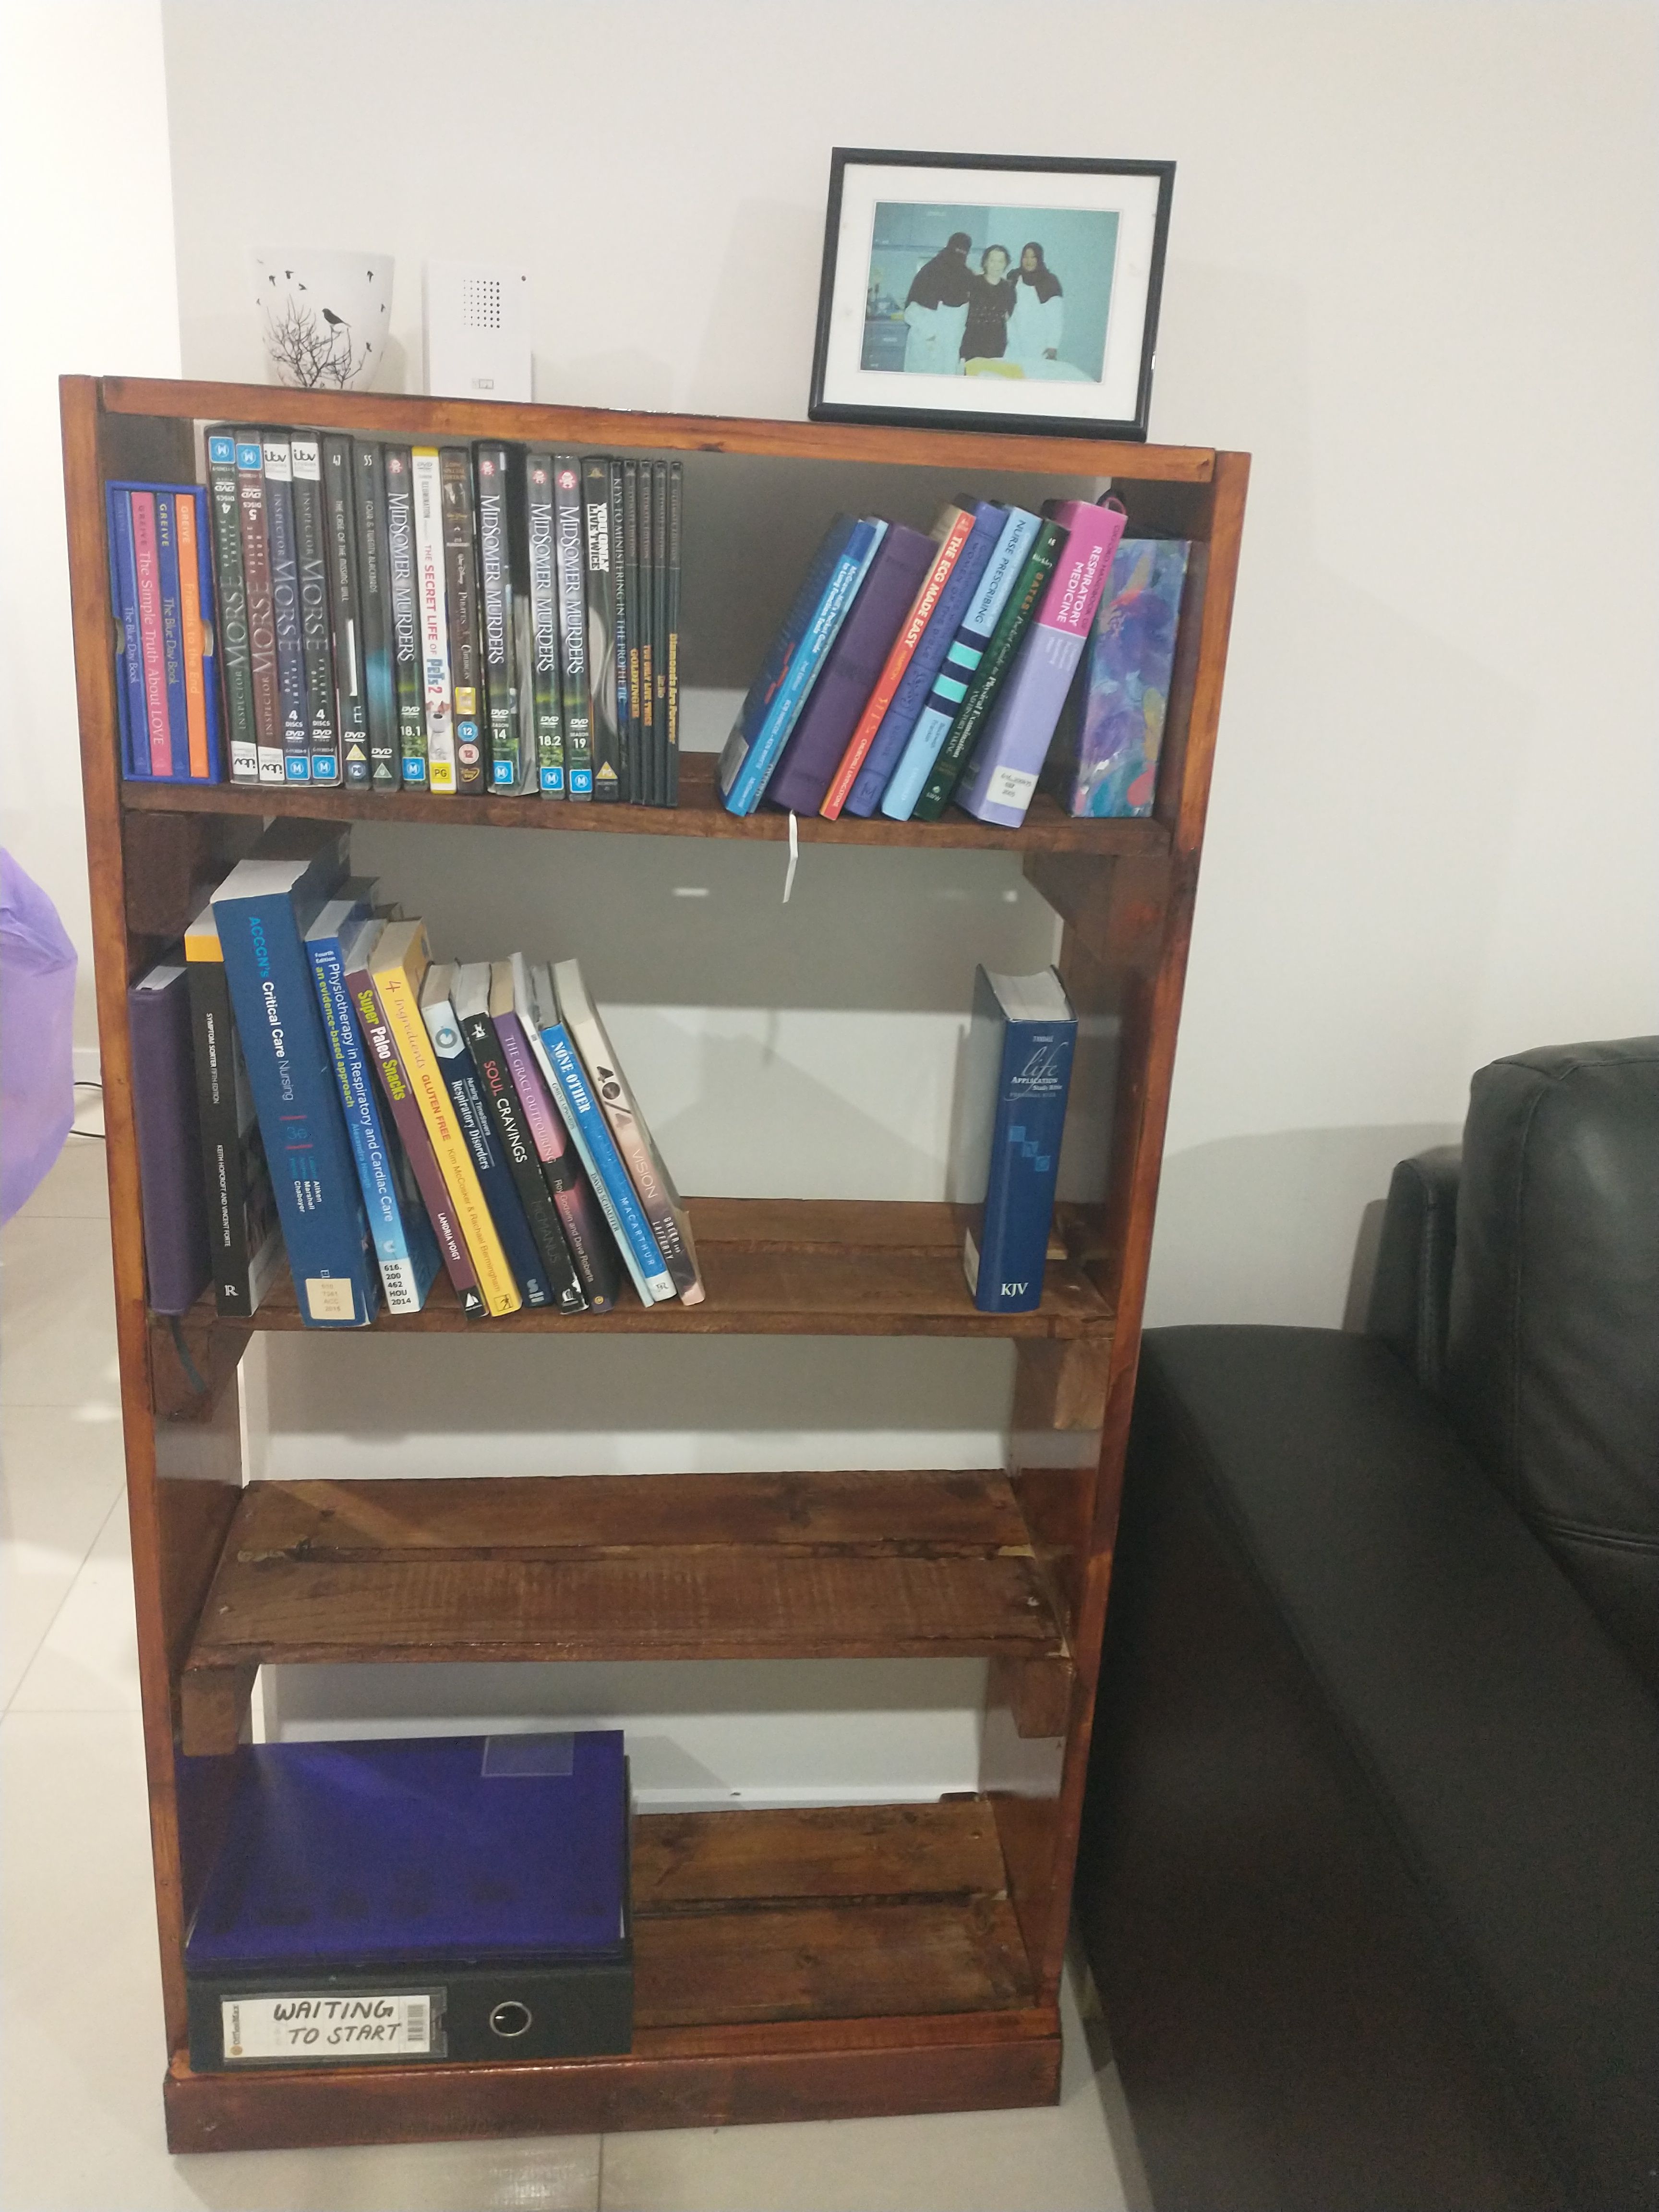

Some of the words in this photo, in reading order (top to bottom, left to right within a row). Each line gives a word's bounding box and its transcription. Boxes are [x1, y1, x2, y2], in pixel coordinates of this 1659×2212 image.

[264, 450, 287, 462] itv
[294, 449, 316, 461] itv
[364, 455, 372, 466] 55
[180, 505, 191, 543] GREIVE
[222, 503, 231, 514] 4
[249, 509, 257, 520] 5
[275, 494, 285, 555] INSPECTOR
[303, 493, 313, 555] INSPECTOR
[366, 501, 374, 519] FOUR
[589, 505, 599, 531] LIVE
[597, 503, 608, 533] YOU
[614, 508, 624, 523] TO
[159, 504, 169, 547] GREIVE
[387, 493, 410, 580] MIDSOMER
[481, 494, 501, 582] MIDSOMER
[1004, 518, 1026, 555] NURSE
[531, 503, 552, 590] MIDSOMER
[559, 505, 580, 593] MIDSOMER
[590, 535, 600, 569] TWICE
[598, 534, 609, 572] ONLY
[615, 526, 625, 600] MINISTERING
[945, 536, 963, 559] THE
[140, 552, 150, 576] The
[934, 560, 951, 583] ECG
[424, 565, 436, 612] SECRET
[917, 583, 940, 618] MADE
[974, 556, 1010, 625] PRESCRIBING
[1055, 560, 1085, 624] MEDICINE
[1067, 544, 1103, 626] RESPIRATORY
[124, 606, 134, 623] The
[140, 580, 157, 625] Simple
[164, 598, 175, 615] The
[184, 583, 196, 627] Friends
[275, 560, 301, 651] MORSE
[302, 560, 328, 651] MORSE
[616, 603, 625, 615] IN
[126, 625, 136, 640] Blue
[165, 617, 177, 637] Blue
[220, 576, 248, 666] MORSE
[246, 582, 275, 672] MORSE
[395, 588, 415, 663] MURDERS
[427, 615, 438, 640] LIFE
[486, 590, 505, 664] MURDERS
[535, 598, 554, 674] MURDERS
[617, 620, 625, 640] THE
[904, 618, 924, 649] EASY
[127, 644, 137, 661] Day
[145, 629, 159, 662] Truth
[166, 639, 177, 660] Day
[430, 644, 437, 655] OF
[565, 600, 584, 676] MURDERS
[129, 662, 140, 684] Book
[168, 661, 180, 685] Book
[187, 649, 197, 666] the
[617, 643, 627, 703] PROPHETIC
[148, 669, 161, 706] About
[191, 671, 201, 695] End
[973, 675, 997, 710] Physical
[235, 671, 247, 730] INSPECTOR
[262, 677, 273, 736] INSPECTOR
[289, 709, 298, 721] 4
[316, 709, 325, 720] 4
[152, 710, 164, 745] LOVE
[400, 726, 421, 736] 18.1
[463, 727, 472, 735] 12
[493, 729, 506, 739] 14
[539, 735, 561, 746] 18.2
[573, 738, 586, 748] 19
[234, 757, 255, 769] itv
[262, 763, 282, 774] itv
[434, 769, 447, 777] PG
[315, 966, 325, 980] an
[262, 981, 281, 1026] Critical
[319, 981, 345, 1059] evidence-based
[328, 963, 354, 1046] Physiotherapy
[206, 1012, 215, 1045] SYMPTOM
[385, 980, 401, 993] 4
[394, 999, 426, 1069] Ingredients
[209, 1045, 217, 1068] SORTER
[272, 1028, 285, 1058] Care
[347, 1048, 358, 1060] in
[358, 989, 379, 1025] Super
[370, 1026, 391, 1059] Paleo
[382, 1059, 406, 1101] Snacks
[212, 1083, 220, 1104] EDITION
[278, 1059, 294, 1101] Nursing
[337, 1060, 355, 1108] approach
[350, 1062, 373, 1126] Respiratory
[551, 1041, 575, 1073] NONE
[565, 1073, 591, 1114] OTHER
[422, 1074, 441, 1115] GLUTEN
[435, 1115, 451, 1142] FREE
[483, 1060, 504, 1097] SOUL
[497, 1098, 528, 1163] CRAVINGS
[505, 1034, 520, 1057] THE
[513, 1059, 532, 1093] GRACE
[526, 1095, 557, 1165] OUTPOURING
[351, 1122, 365, 1161] Alexandra
[364, 1129, 380, 1149] and
[451, 1080, 476, 1129] Respiratory
[469, 1129, 490, 1170] Disorders
[371, 1152, 387, 1194] Cardiac
[590, 1173, 604, 1194] DAVID
[632, 1148, 659, 1199] VISION
[294, 1180, 305, 1213] Chaboyer
[303, 1180, 315, 1210] Marshall
[313, 1181, 322, 1203] Aitken
[222, 1206, 230, 1229] VINCENT
[381, 1196, 393, 1222] Care
[448, 1148, 457, 1165] Kim
[453, 1166, 471, 1204] McCosker
[470, 1213, 485, 1244] Rachael
[481, 1244, 501, 1292] Bermingham
[437, 1213, 453, 1240] LANDRIA
[447, 1239, 461, 1261] VOIGT
[554, 1178, 564, 1194] Roy
[560, 1195, 574, 1223] Godwin
[569, 1223, 579, 1236] and
[574, 1237, 585, 1255] Dave
[580, 1255, 594, 1283] Roberts
[620, 1196, 655, 1266] MACARTHUR
[652, 1221, 673, 1260] LAFFERTY
[1000, 1282, 1029, 1297] KJV
[274, 2000, 395, 2021] WAITING
[288, 2028, 319, 2044] TO
[327, 2022, 402, 2044] START
